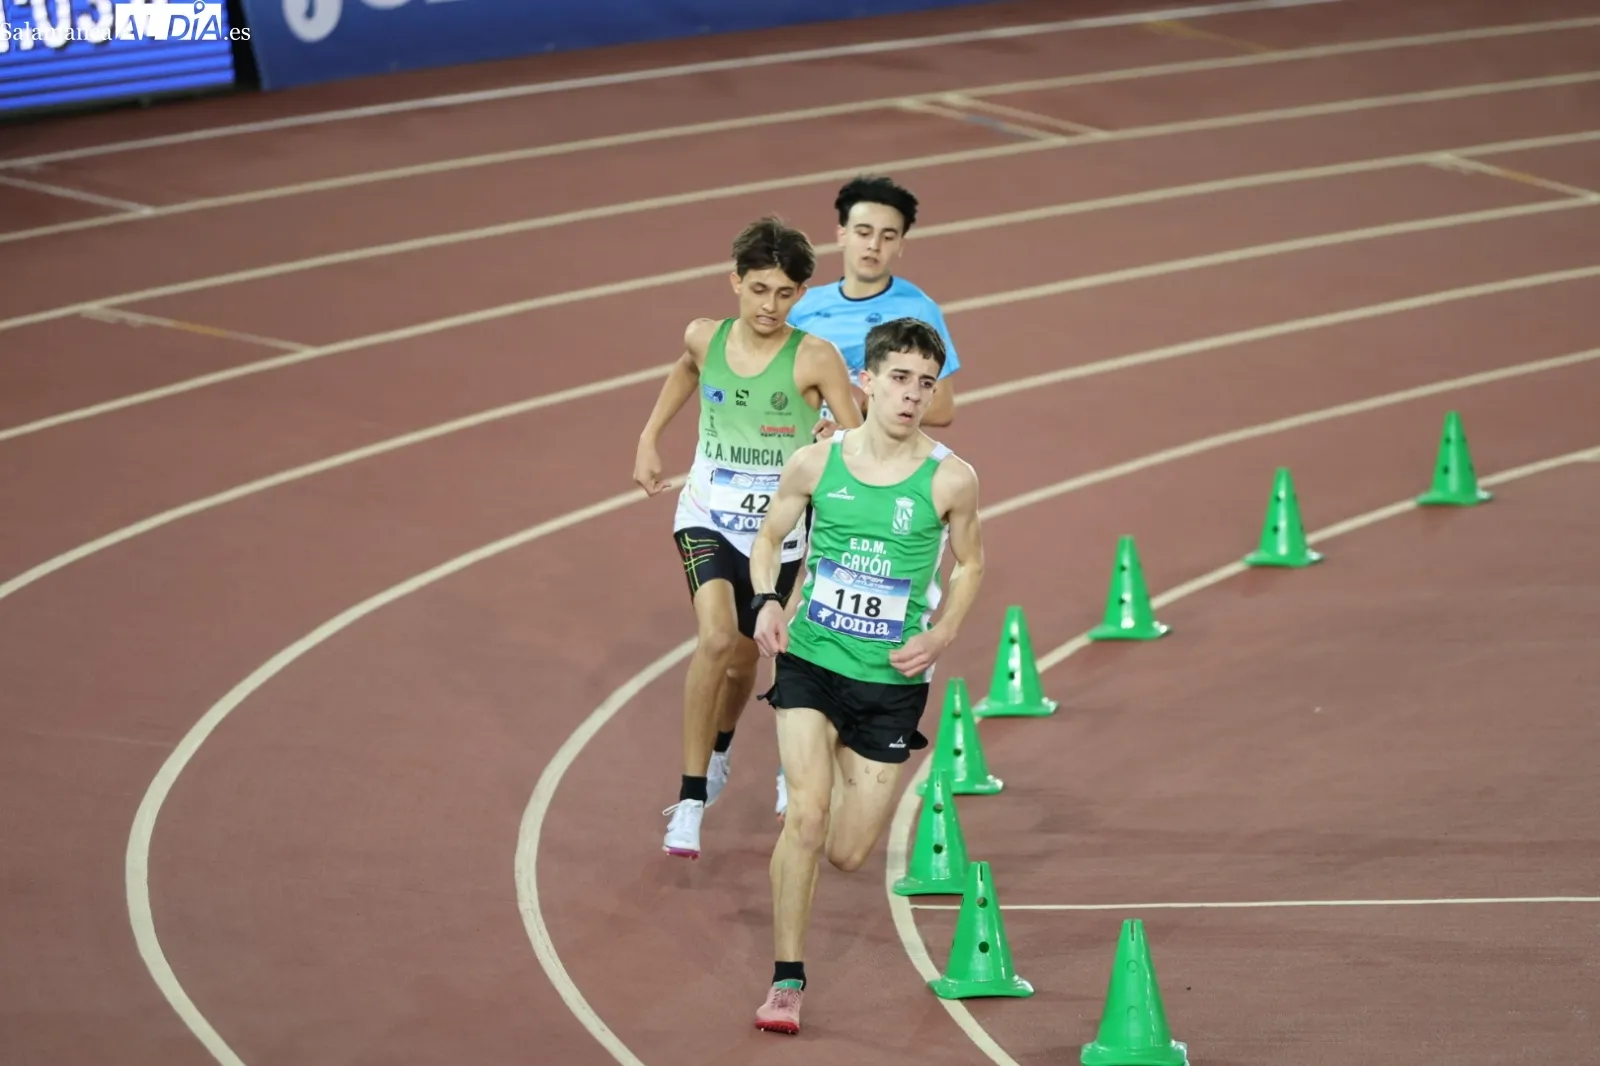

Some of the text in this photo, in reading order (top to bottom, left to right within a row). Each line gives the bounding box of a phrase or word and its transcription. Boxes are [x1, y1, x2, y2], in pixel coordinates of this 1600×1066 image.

[735, 399, 748, 407] SDL
[730, 445, 784, 467] MURCIA
[740, 493, 771, 514] 42
[849, 537, 887, 555] E.D.M.
[840, 551, 892, 577] CAYÓN
[834, 588, 882, 618] 118
